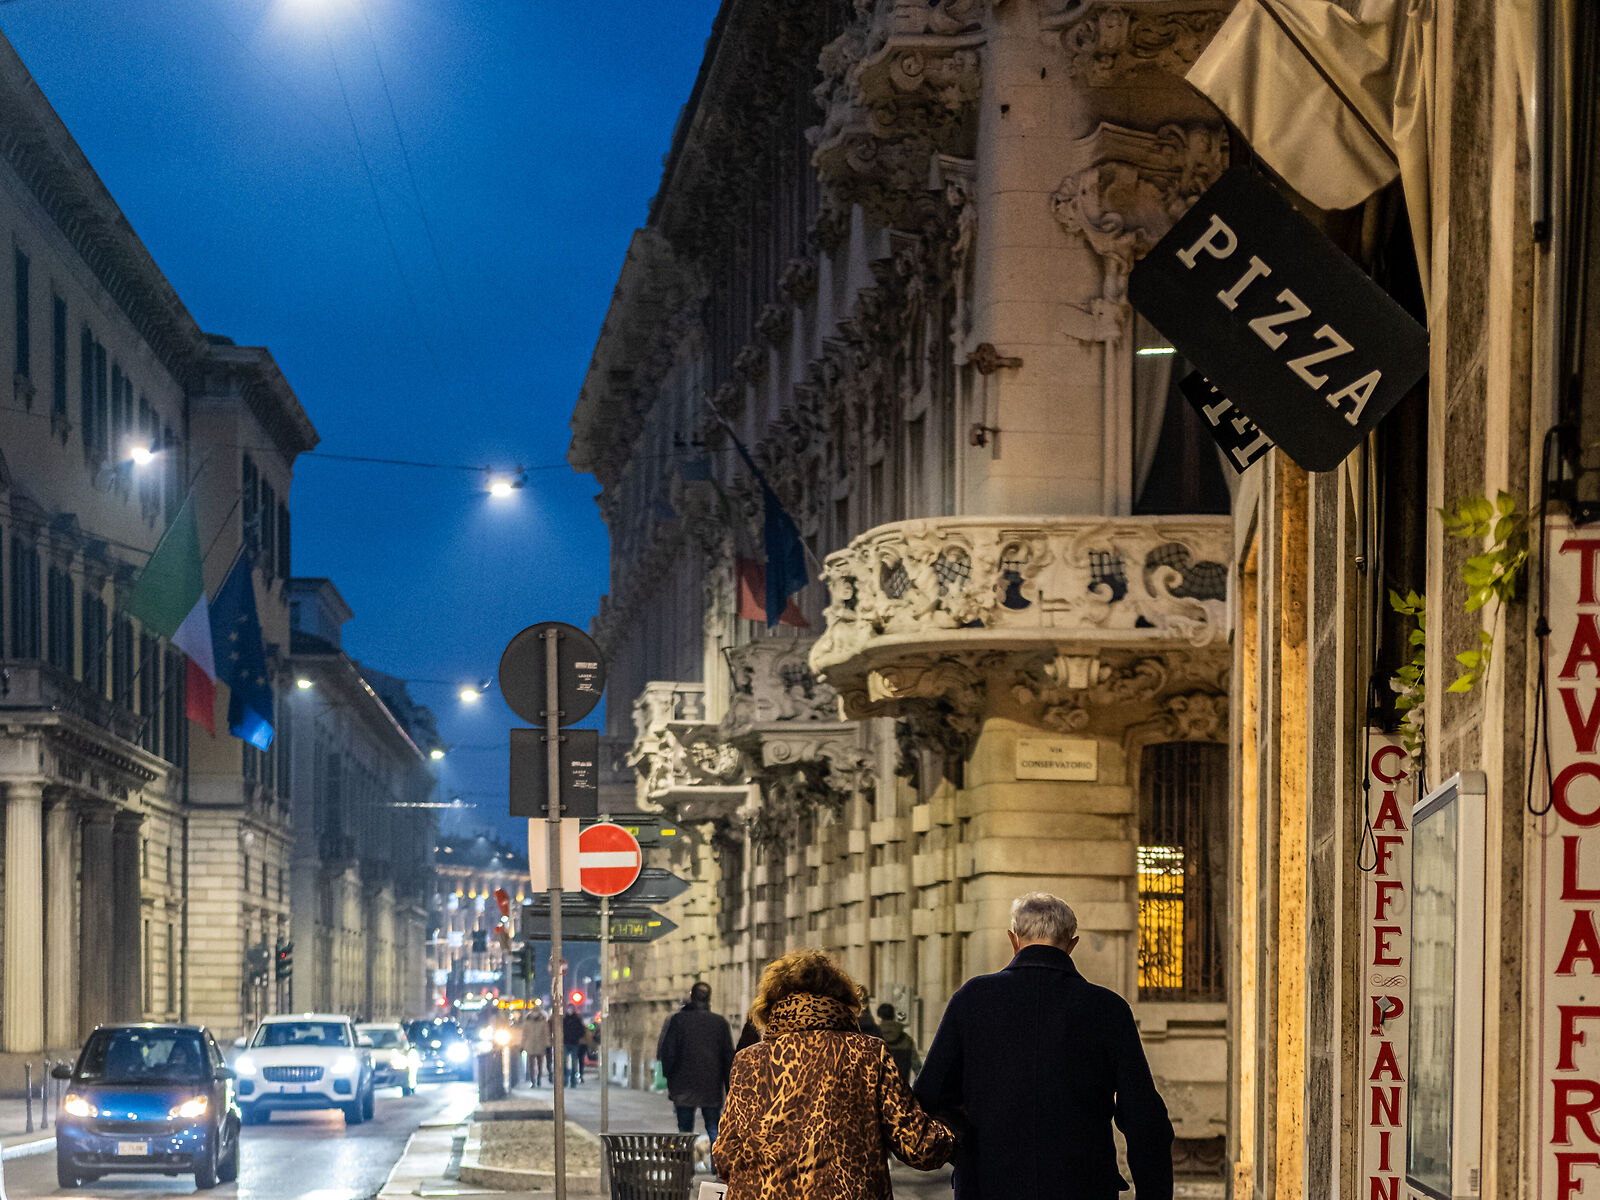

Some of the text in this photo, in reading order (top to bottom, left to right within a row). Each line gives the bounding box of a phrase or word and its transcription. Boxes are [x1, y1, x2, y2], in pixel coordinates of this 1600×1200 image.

[1176, 213, 1382, 426] PIZZA
[1371, 745, 1409, 968] CAFFE
[1552, 539, 1600, 977] TAVOLA
